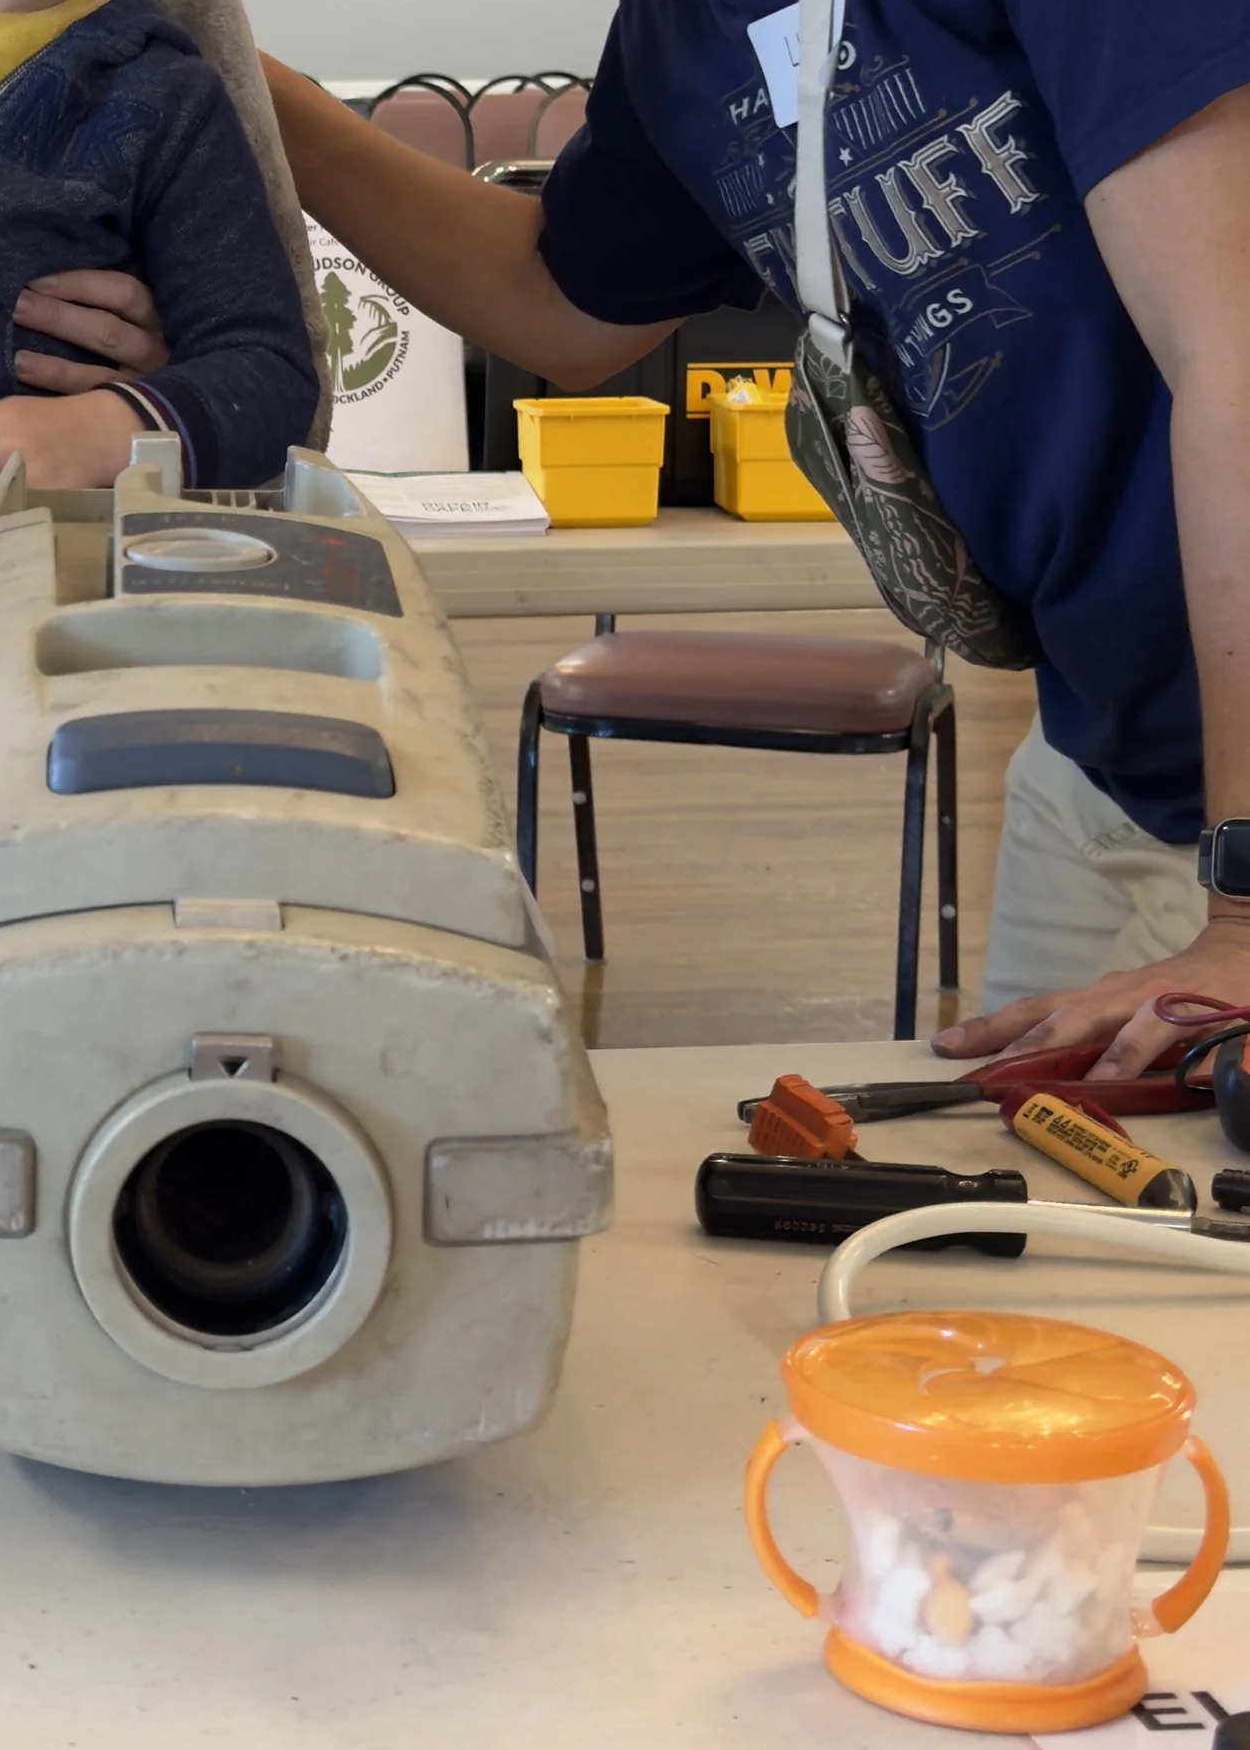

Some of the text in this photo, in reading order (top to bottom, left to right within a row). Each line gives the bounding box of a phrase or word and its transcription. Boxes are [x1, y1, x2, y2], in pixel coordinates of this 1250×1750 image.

[828, 90, 1042, 291] TUFF
[314, 256, 367, 277] UDSON
[334, 330, 410, 405] OCKLAND PUTNAM
